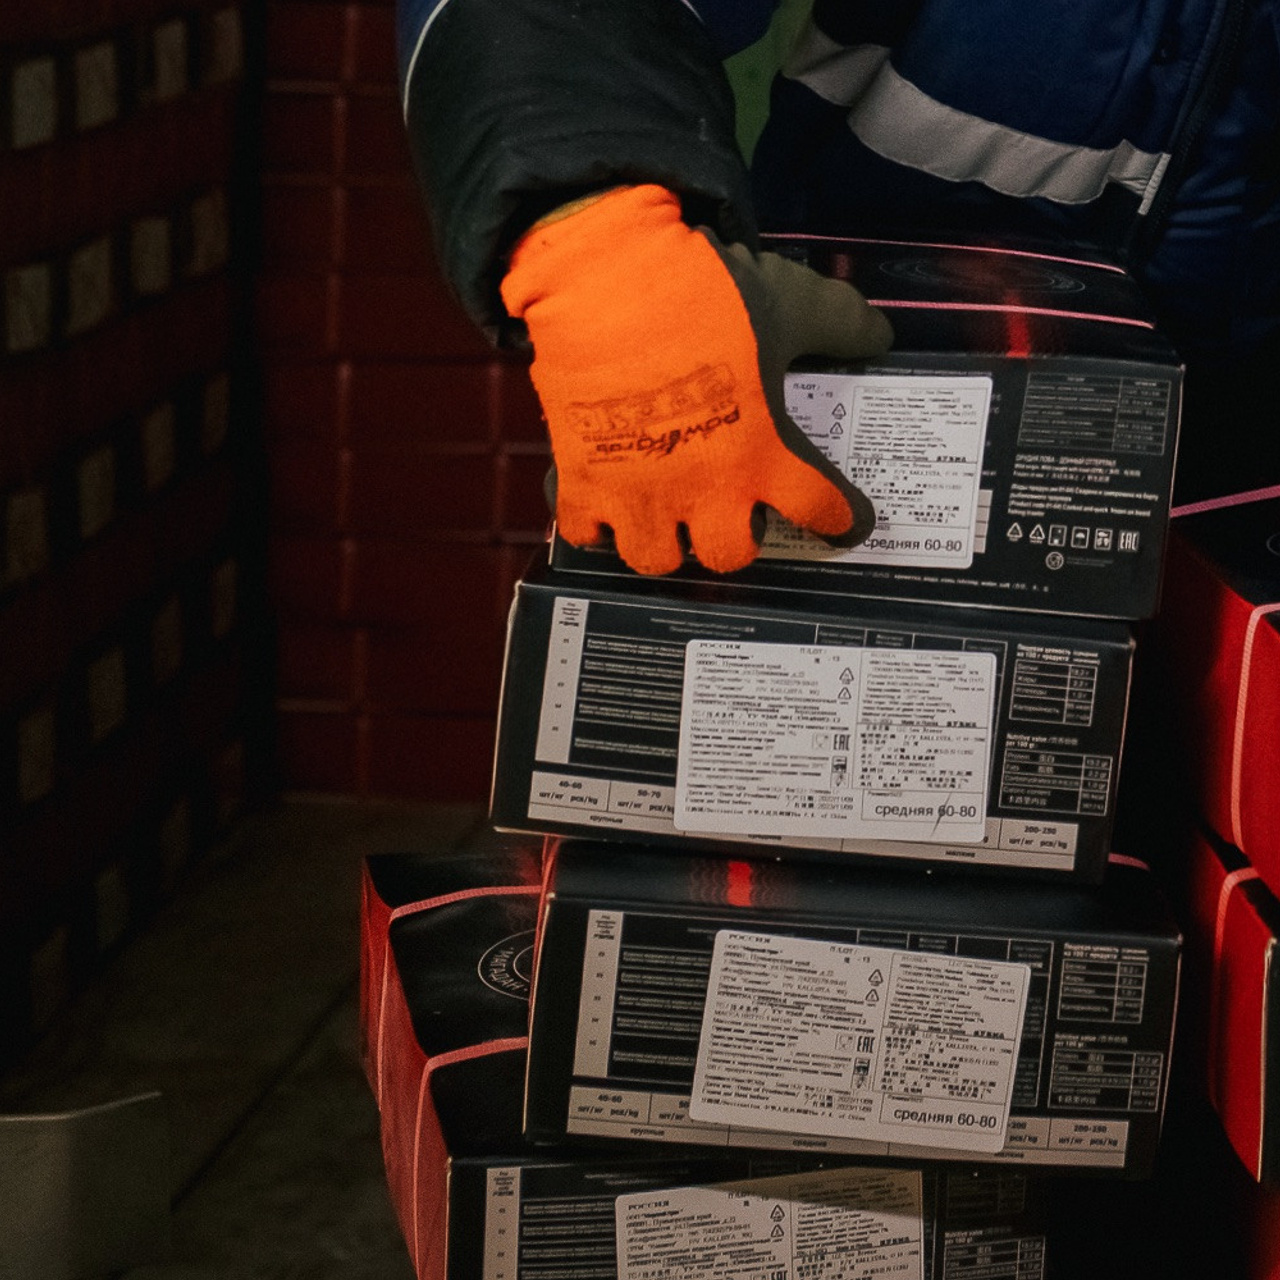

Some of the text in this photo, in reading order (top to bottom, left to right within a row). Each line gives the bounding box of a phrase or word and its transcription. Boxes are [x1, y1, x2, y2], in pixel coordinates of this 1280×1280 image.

[863, 539, 962, 552] средняя 60-80
[875, 804, 933, 818] средняя
[893, 1108, 997, 1129] средняя 60-80
